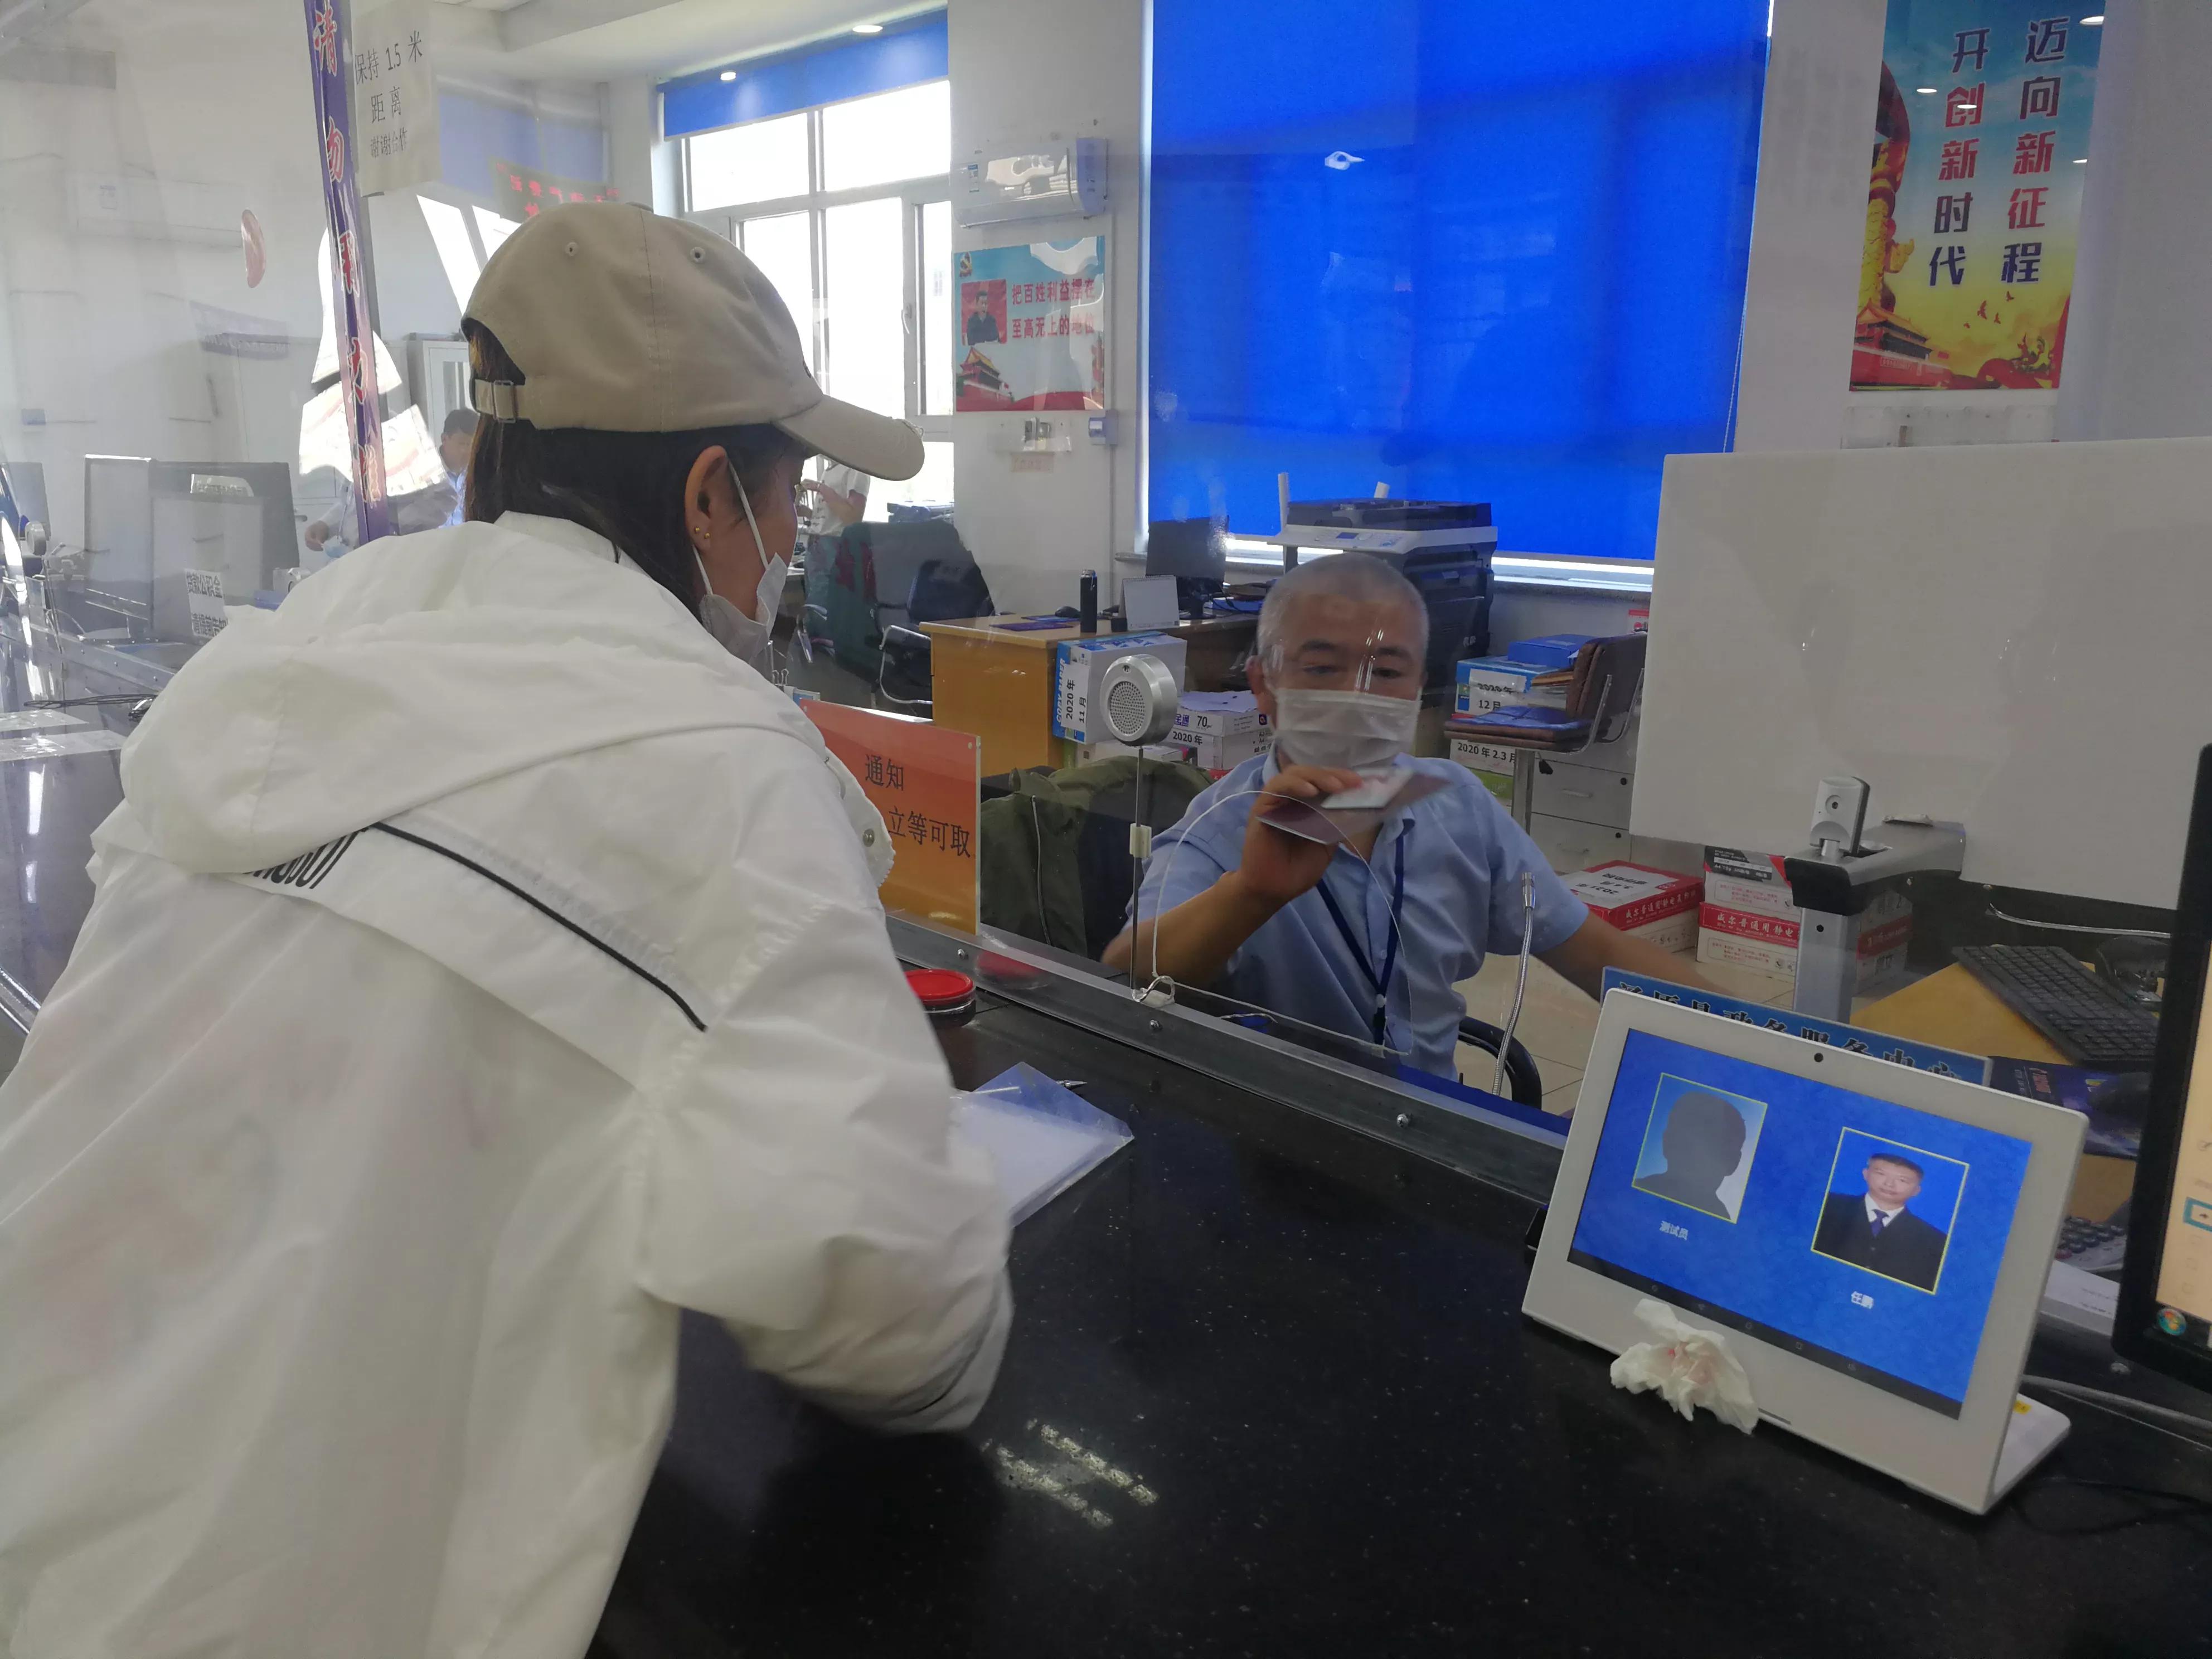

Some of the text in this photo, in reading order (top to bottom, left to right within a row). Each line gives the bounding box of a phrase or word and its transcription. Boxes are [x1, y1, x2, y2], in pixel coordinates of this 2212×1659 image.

[371, 85, 402, 123] 距离
[370, 127, 408, 158] 谢谢合作
[1929, 28, 1990, 287] 开创新时代
[2000, 16, 2070, 284] 迈向新征程
[1012, 279, 1095, 305] 把百姓利益摆在
[1012, 314, 1095, 338] 至高无上的地位
[1066, 679, 1075, 720] 2020年
[1478, 683, 1515, 695] 2020年
[1197, 716, 1207, 727] 70
[1173, 731, 1203, 745] 2020年
[1458, 742, 1517, 763] 2020年2.3月
[865, 754, 904, 791] 通知
[888, 806, 971, 858] 立等可取
